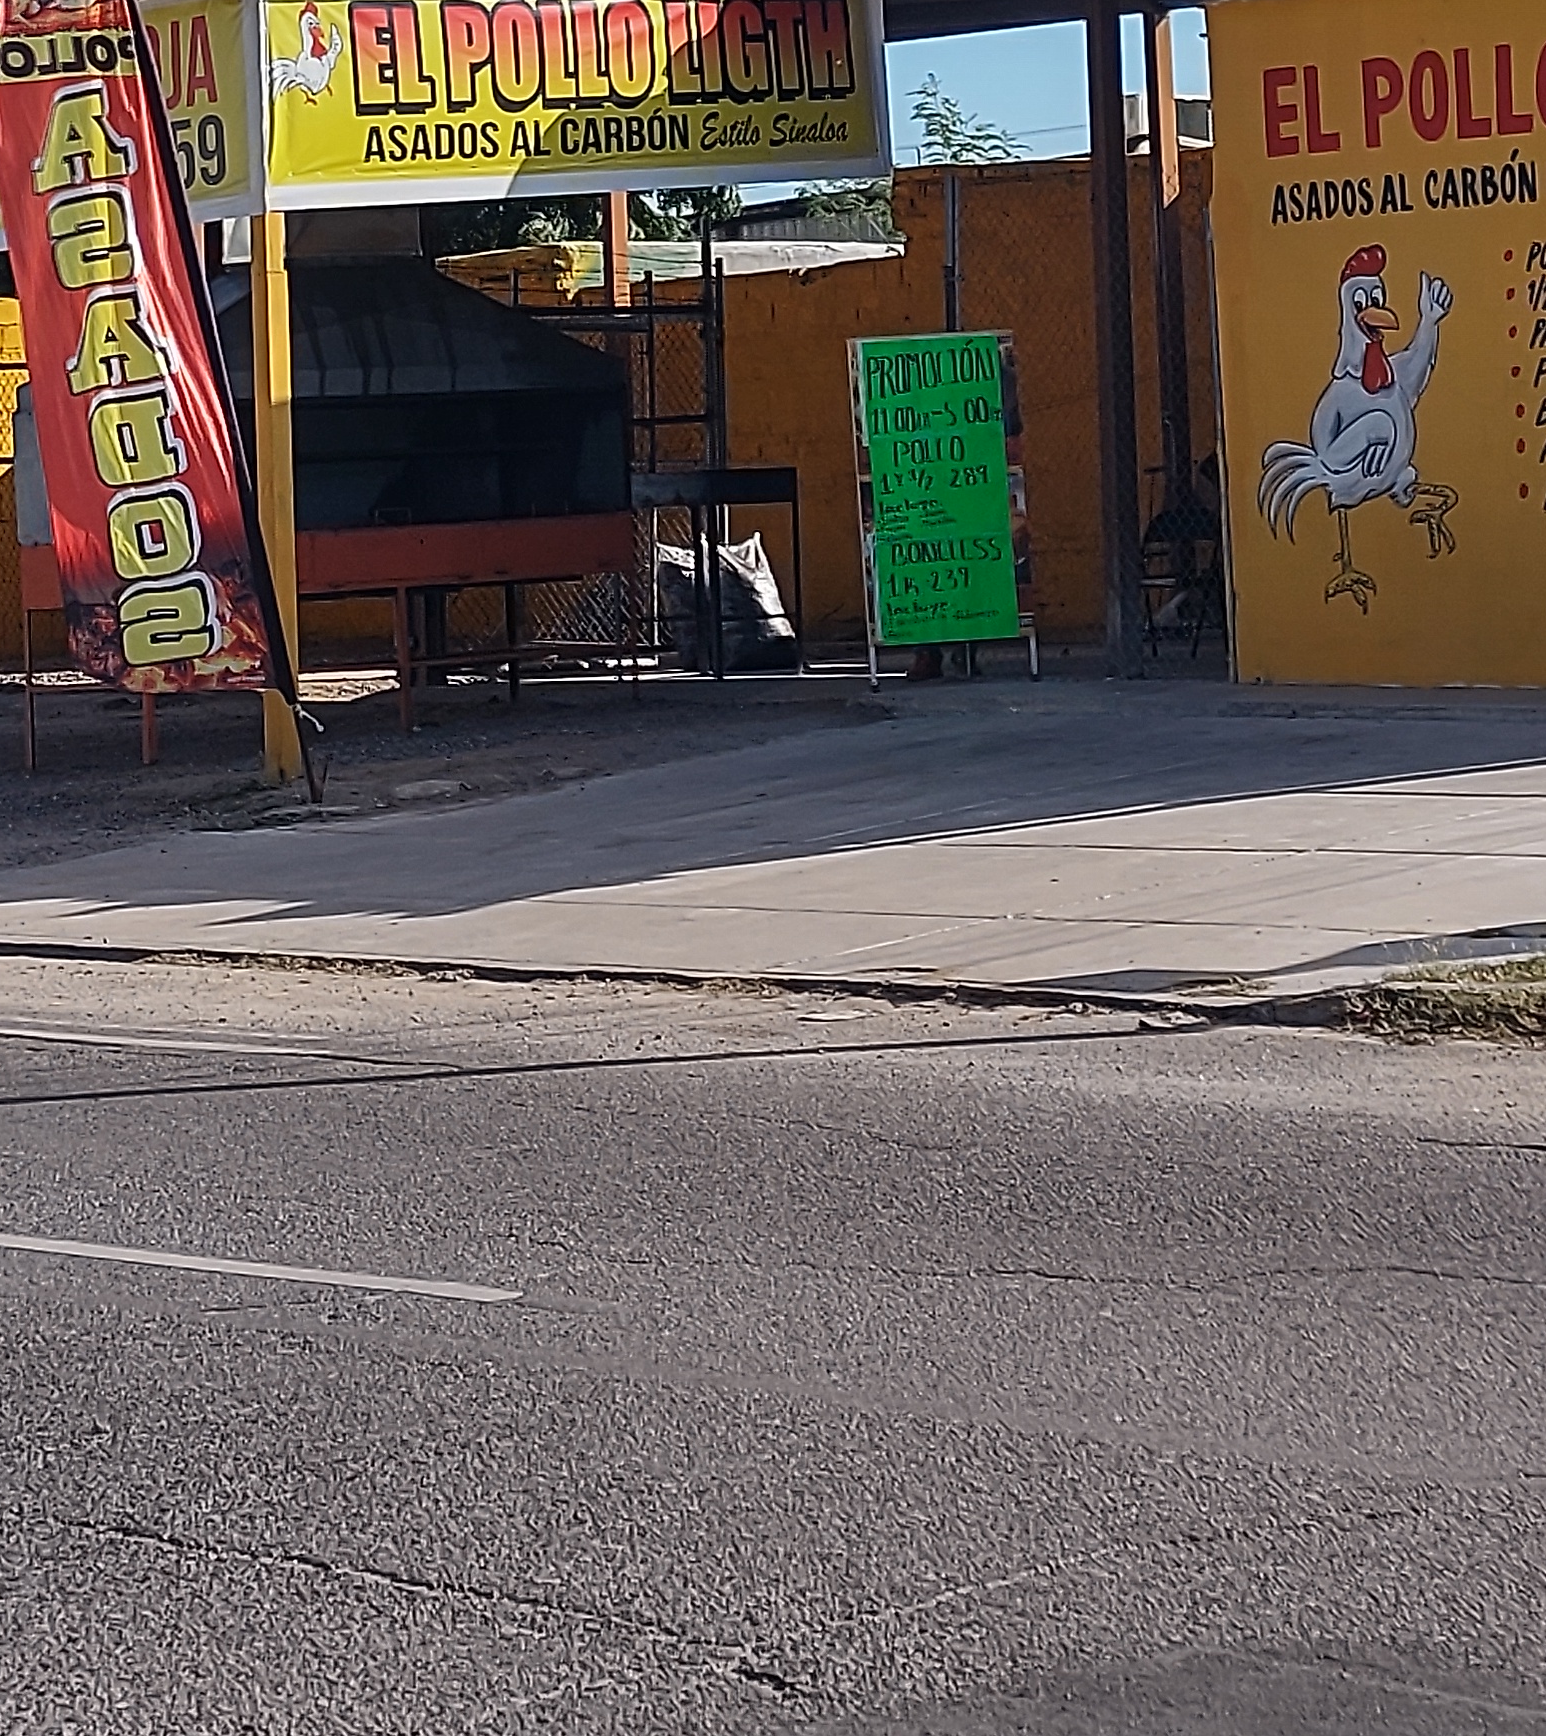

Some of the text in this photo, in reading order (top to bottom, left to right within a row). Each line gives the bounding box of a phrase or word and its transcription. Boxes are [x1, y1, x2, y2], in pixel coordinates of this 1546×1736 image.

[349, 0, 436, 116] EL
[363, 109, 849, 163] ASADOS AL CARBÓN Estilo Sinaloa
[1262, 65, 1341, 158] EL
[1271, 177, 1375, 225] ASADOS
[1378, 173, 1414, 215] AL
[1424, 149, 1537, 210] CARBÓN
[867, 339, 994, 400] PROMOCIÓN
[893, 435, 965, 467] POLLO
